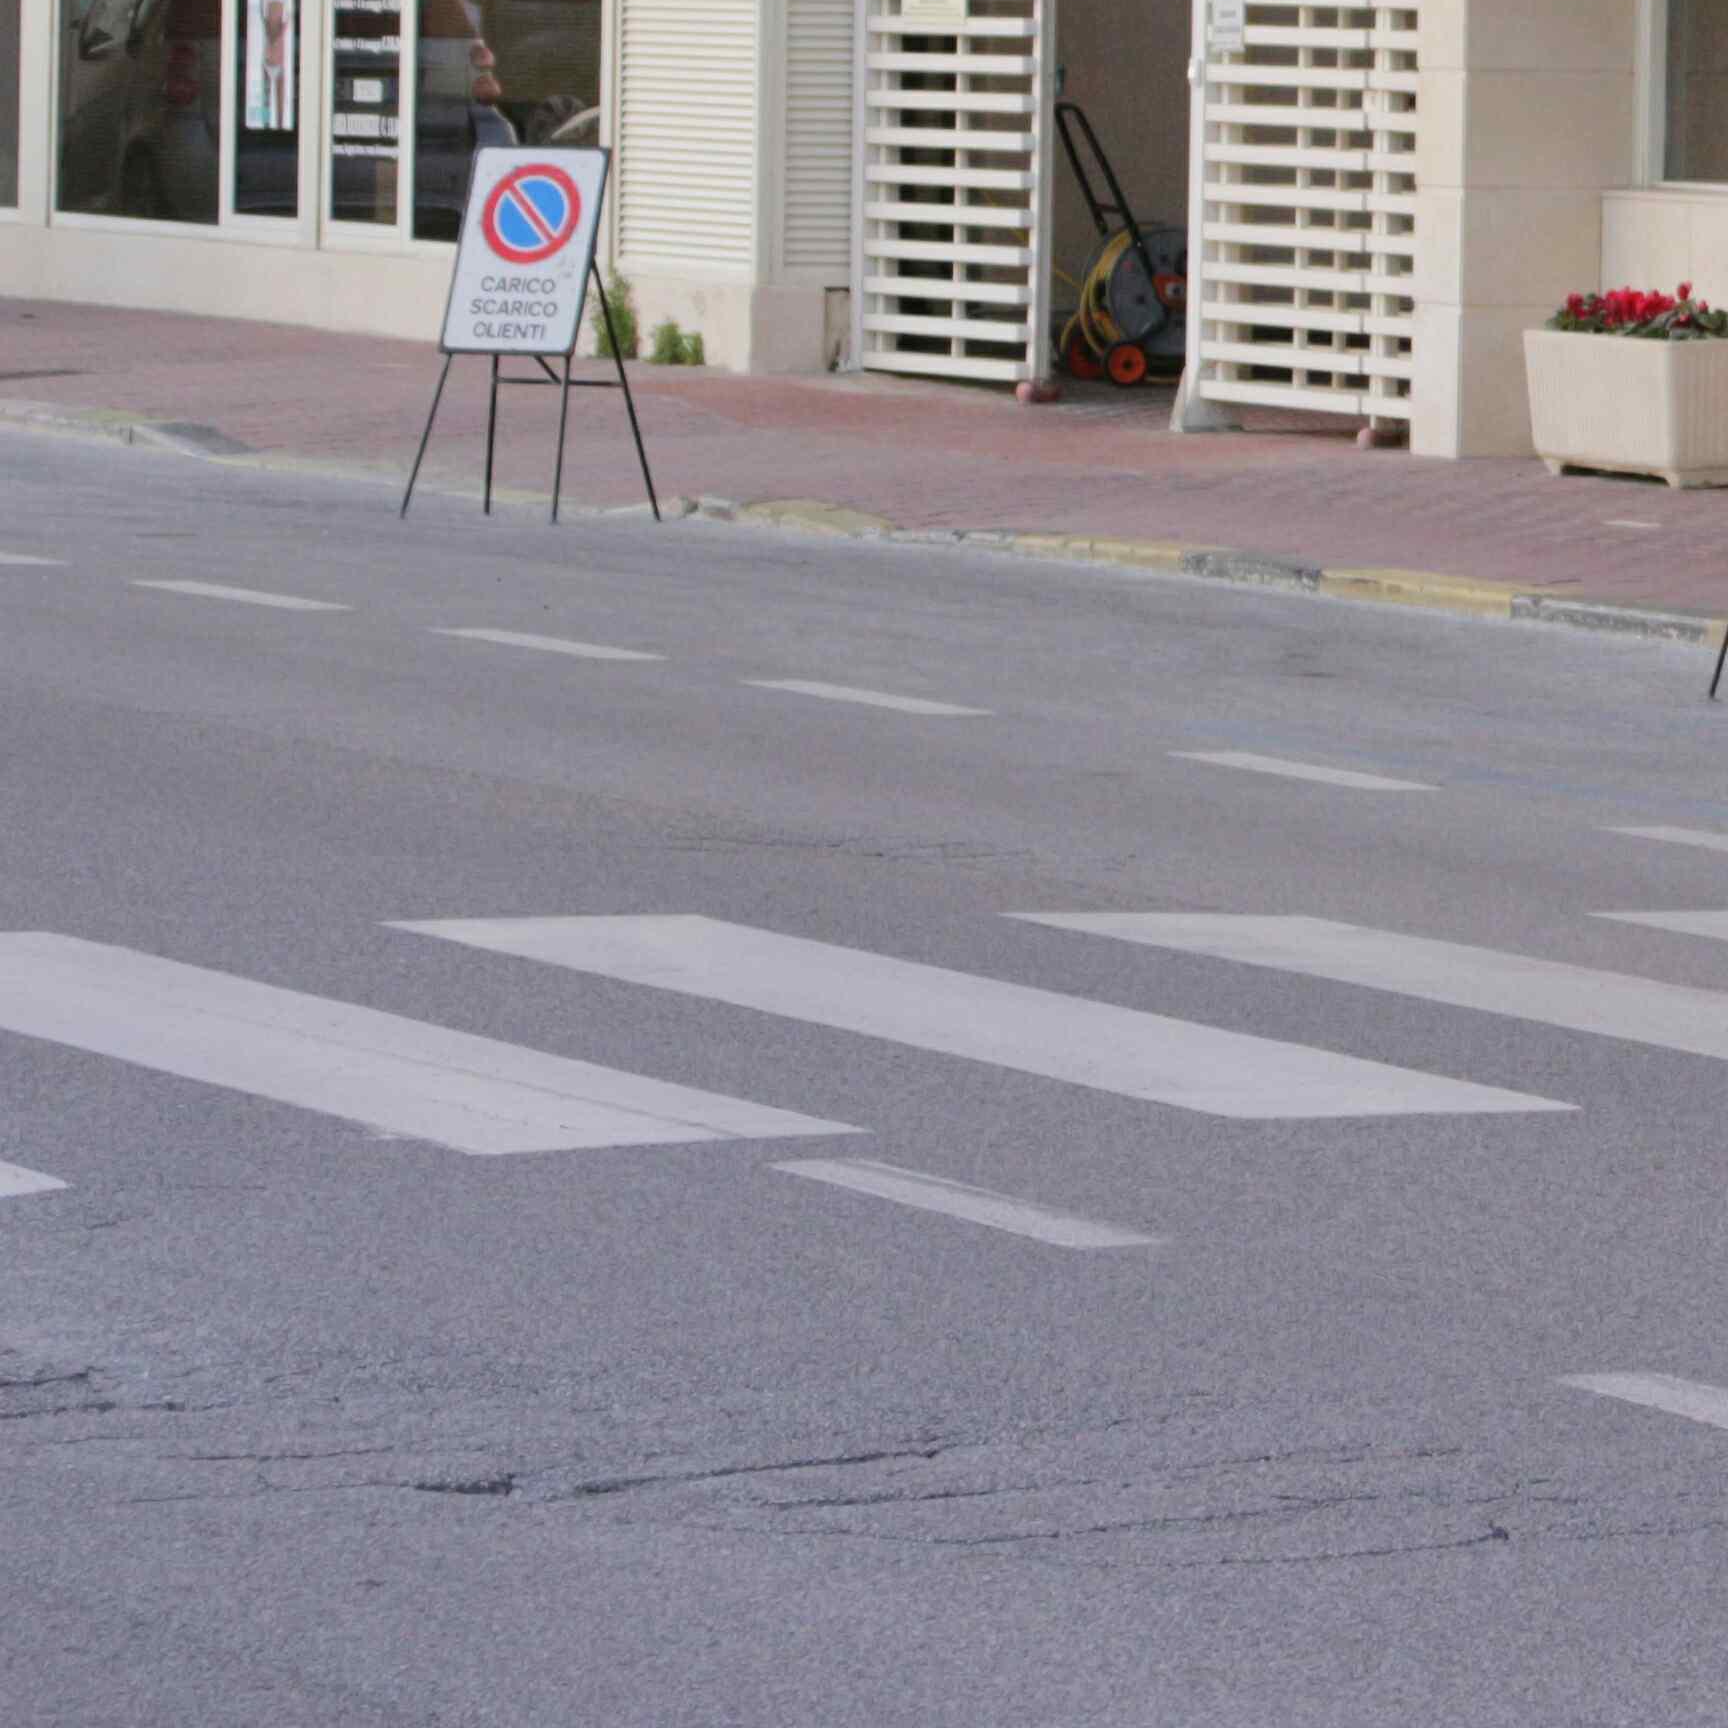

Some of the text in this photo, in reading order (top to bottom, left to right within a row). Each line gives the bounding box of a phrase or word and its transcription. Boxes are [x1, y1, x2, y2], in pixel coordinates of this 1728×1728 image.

[480, 275, 557, 295] CARICO
[469, 298, 558, 318] SCARICO
[472, 321, 547, 340] CLIENTI
